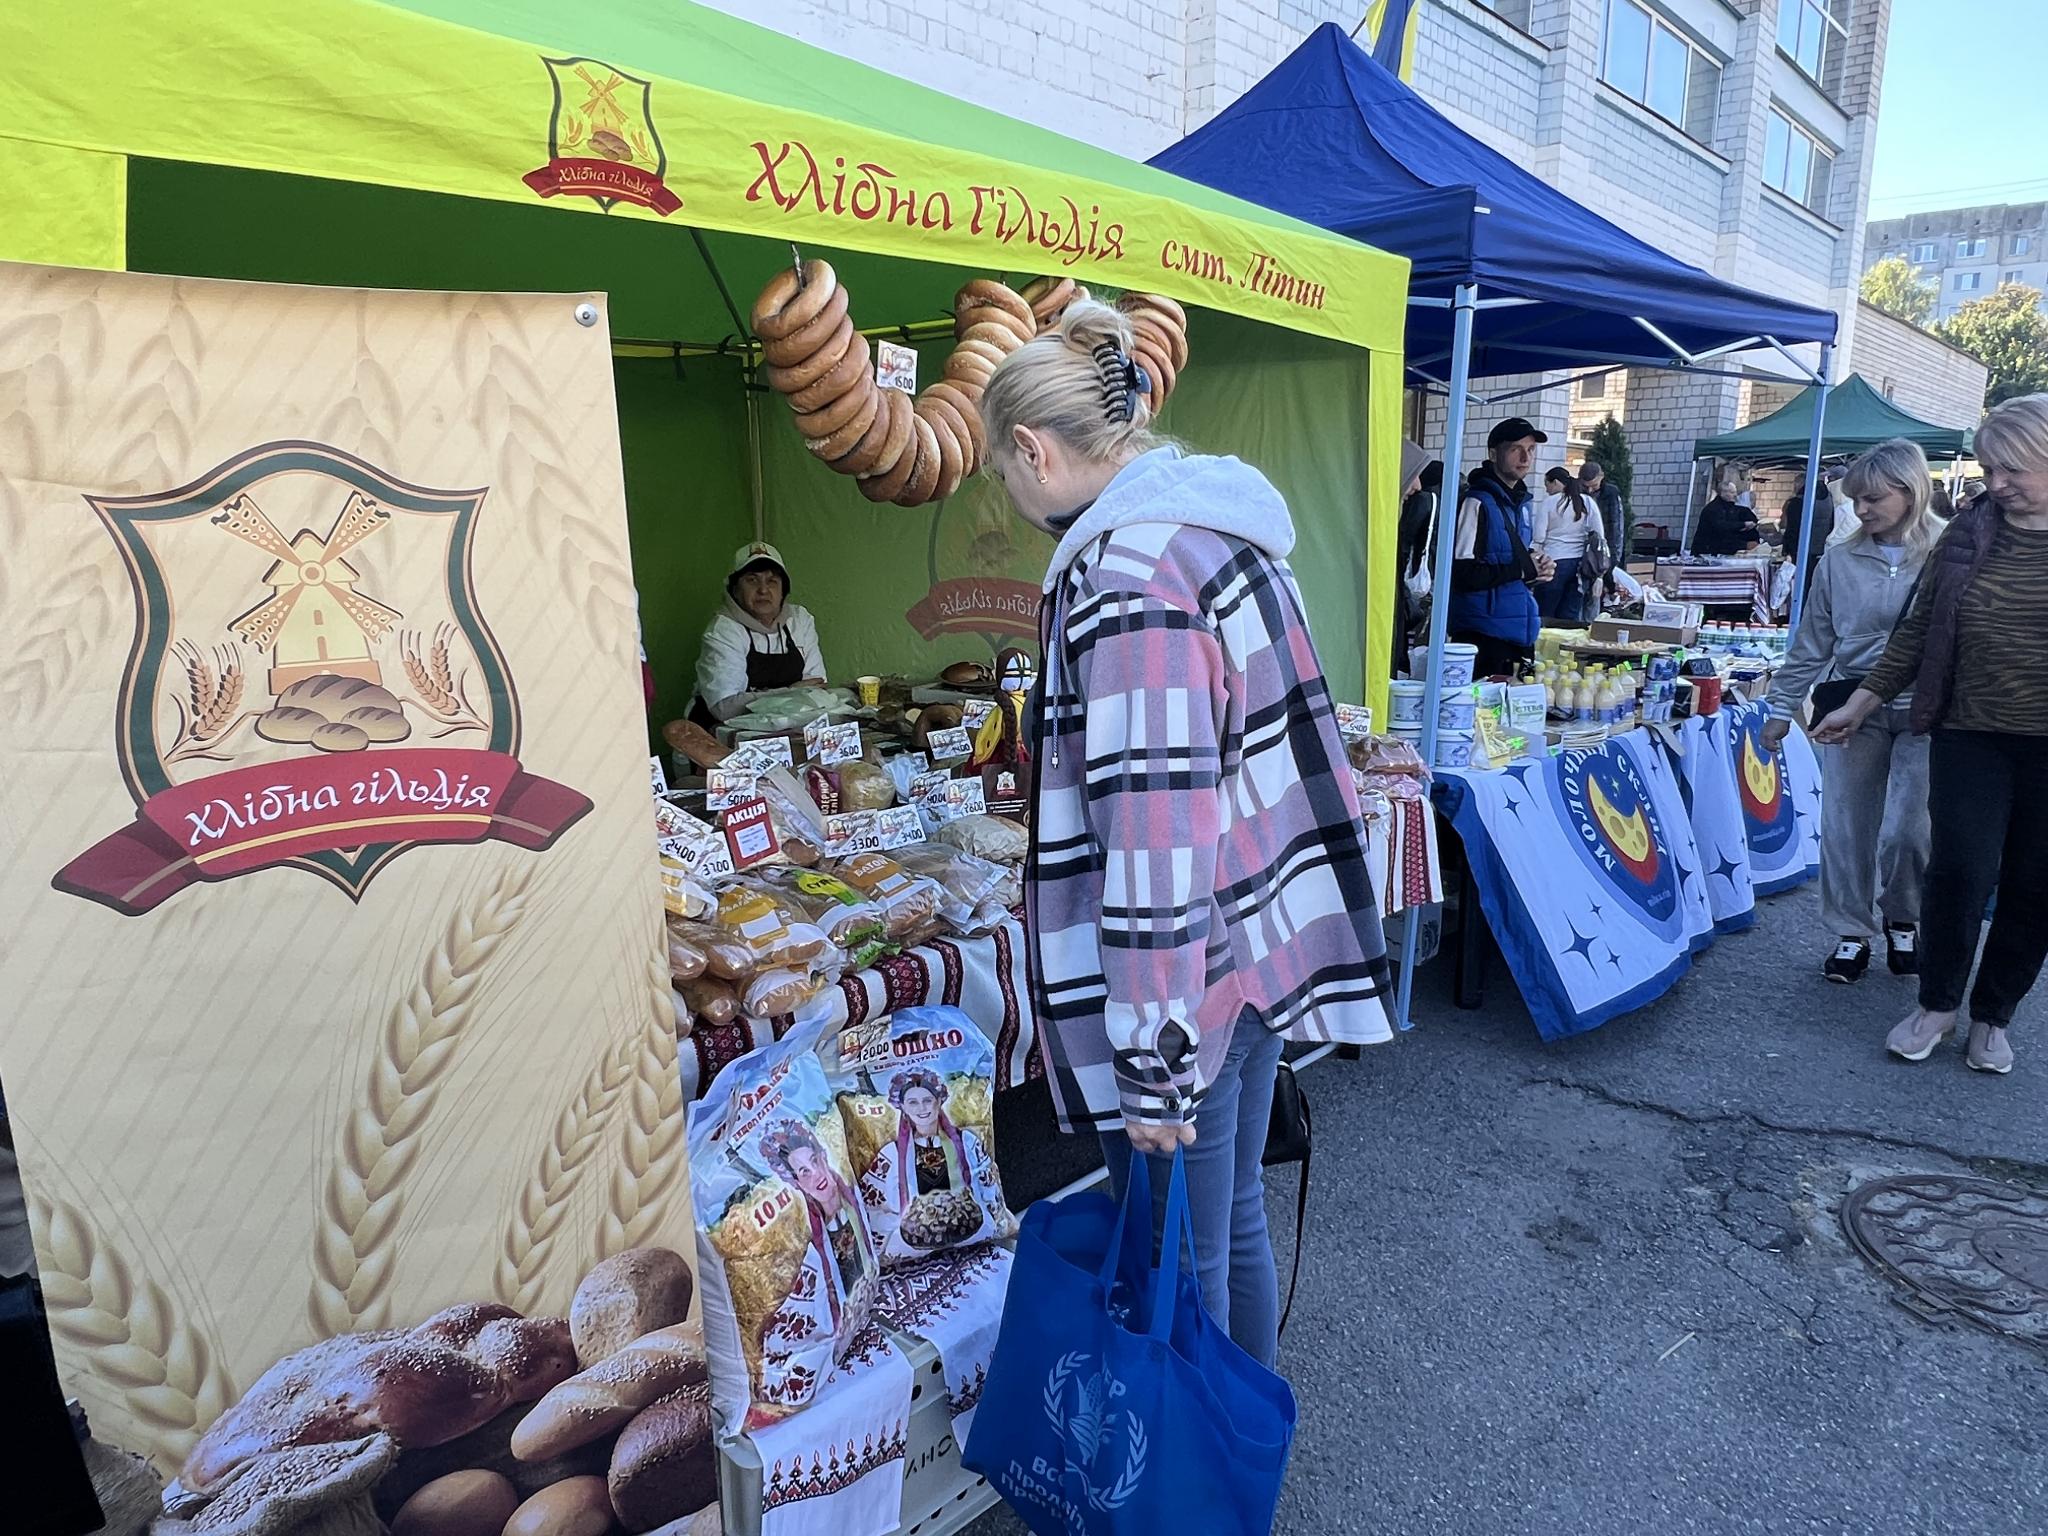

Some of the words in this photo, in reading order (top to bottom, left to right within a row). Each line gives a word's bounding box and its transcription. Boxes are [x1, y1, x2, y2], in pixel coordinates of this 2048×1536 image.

[559, 167, 606, 183] Хлібна
[745, 140, 955, 232] Хлібна
[968, 184, 1125, 266] Гільдія
[1160, 239, 1233, 283] смт.
[1240, 250, 1327, 311] Літин
[184, 783, 341, 847] Хлібна
[349, 767, 491, 811] гільдія
[727, 802, 767, 826] АКЦІЯ
[754, 1200, 776, 1228] 10
